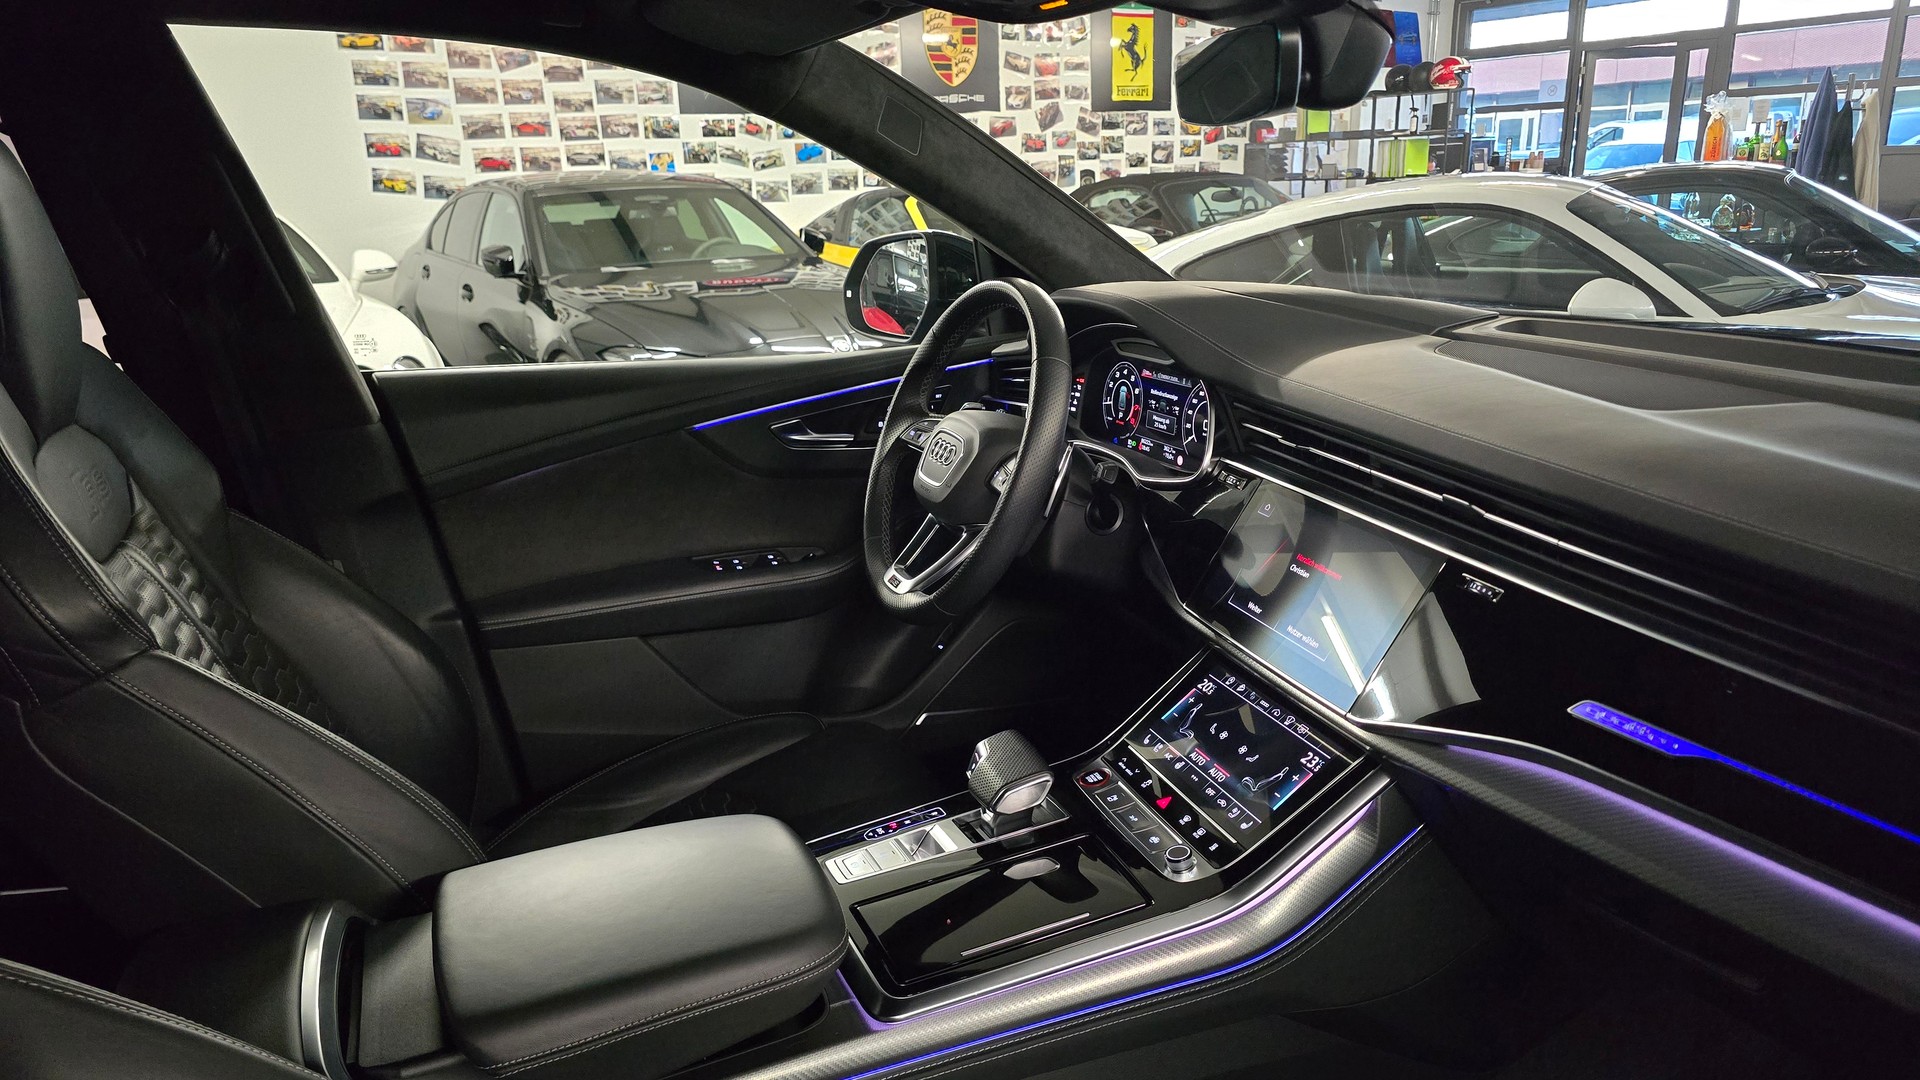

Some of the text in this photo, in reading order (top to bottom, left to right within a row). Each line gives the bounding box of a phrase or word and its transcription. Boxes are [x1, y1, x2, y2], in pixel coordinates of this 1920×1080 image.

[933, 93, 985, 103] RSCHE
[1116, 85, 1149, 97] Ferrari
[1289, 563, 1310, 579] Christian
[1247, 600, 1262, 614] Weiter
[1286, 624, 1320, 649] Nutzer wählen
[1188, 751, 1206, 766] AUTO
[1207, 766, 1226, 783] AUTO
